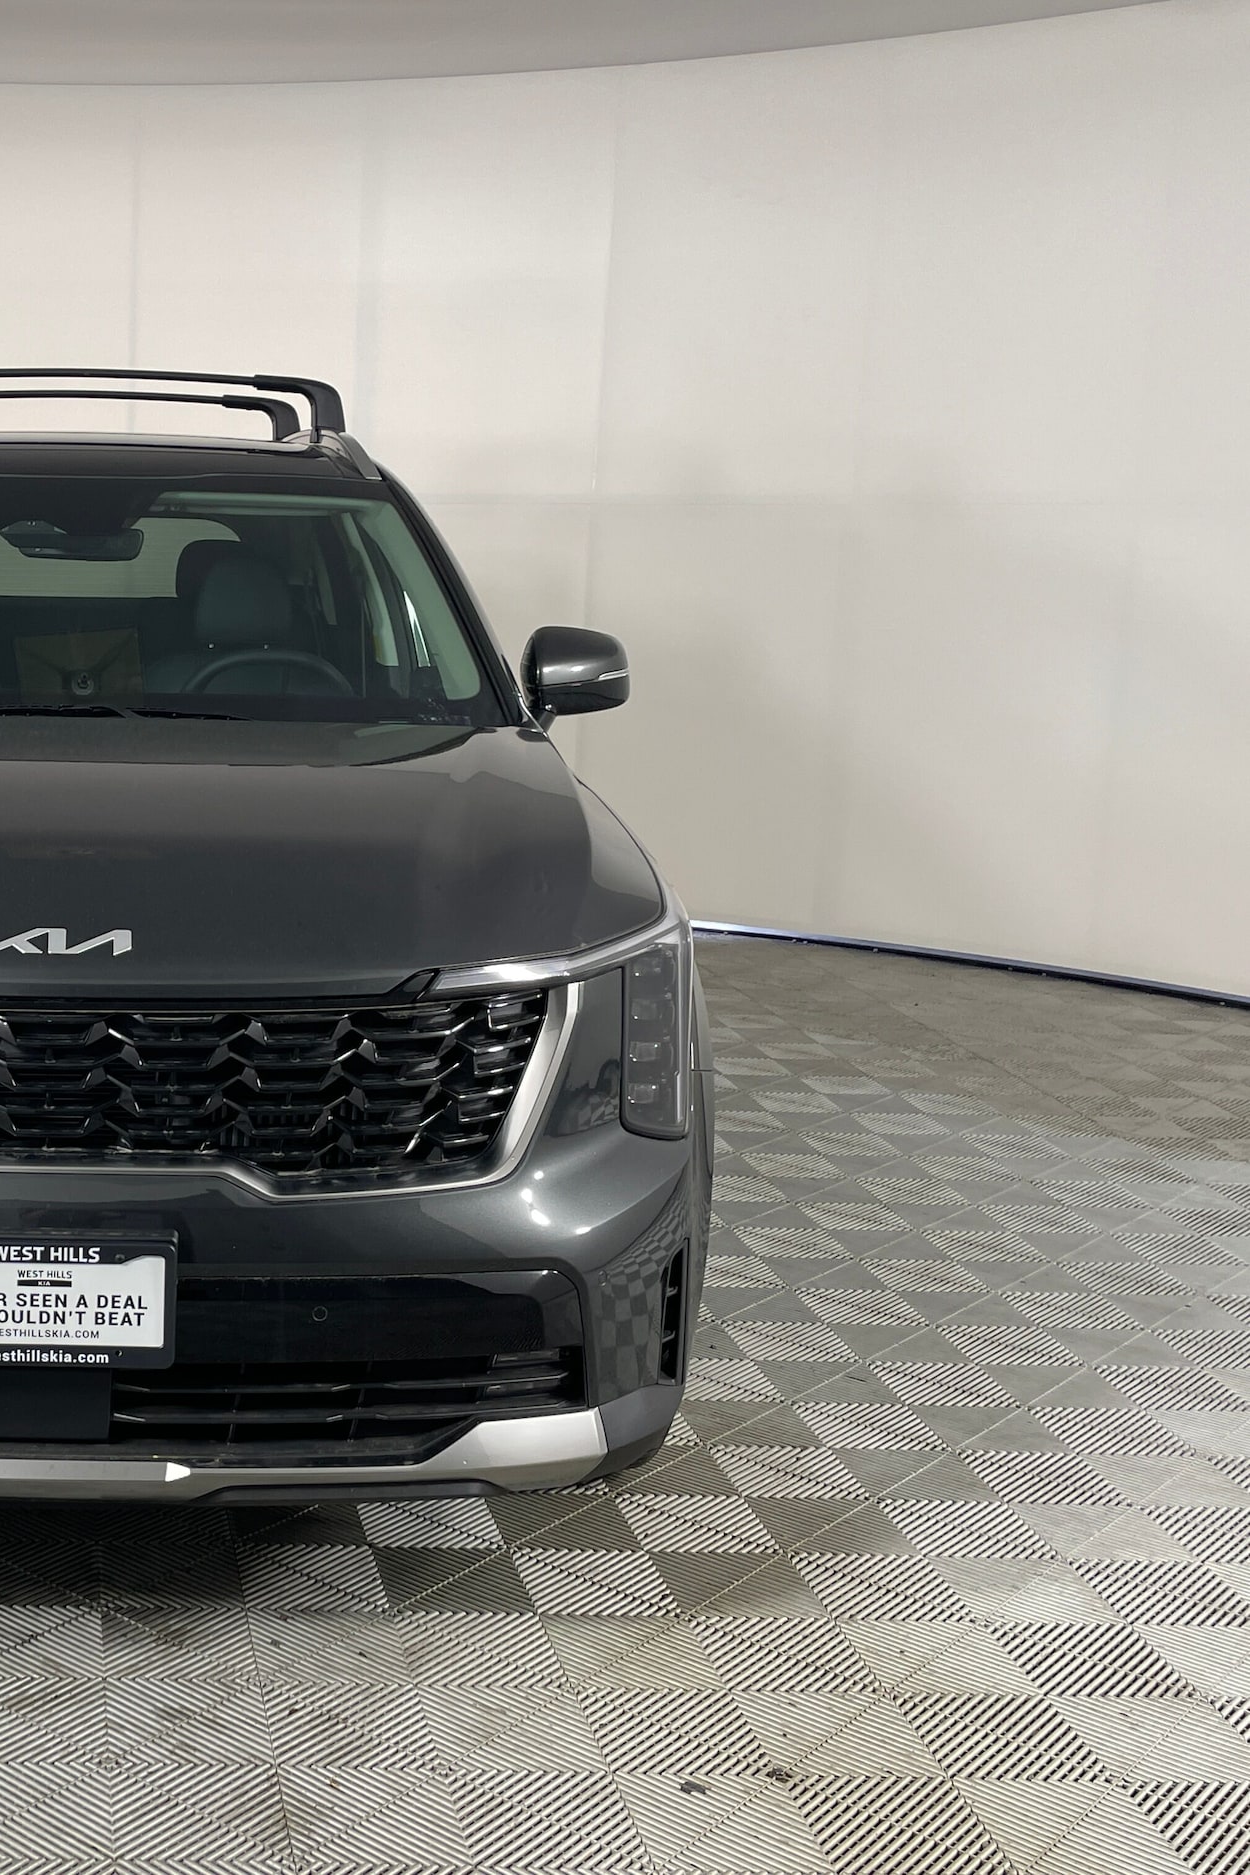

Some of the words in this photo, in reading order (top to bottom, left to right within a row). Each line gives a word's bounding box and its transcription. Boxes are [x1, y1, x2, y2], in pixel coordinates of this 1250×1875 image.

[50, 1247, 100, 1263] HILLS
[17, 1269, 44, 1279] WEST
[47, 1270, 73, 1279] HILLS
[16, 1293, 68, 1308] SEEN
[76, 1294, 89, 1308] A
[97, 1295, 148, 1310] DEAL
[95, 1311, 145, 1326] BEAT
